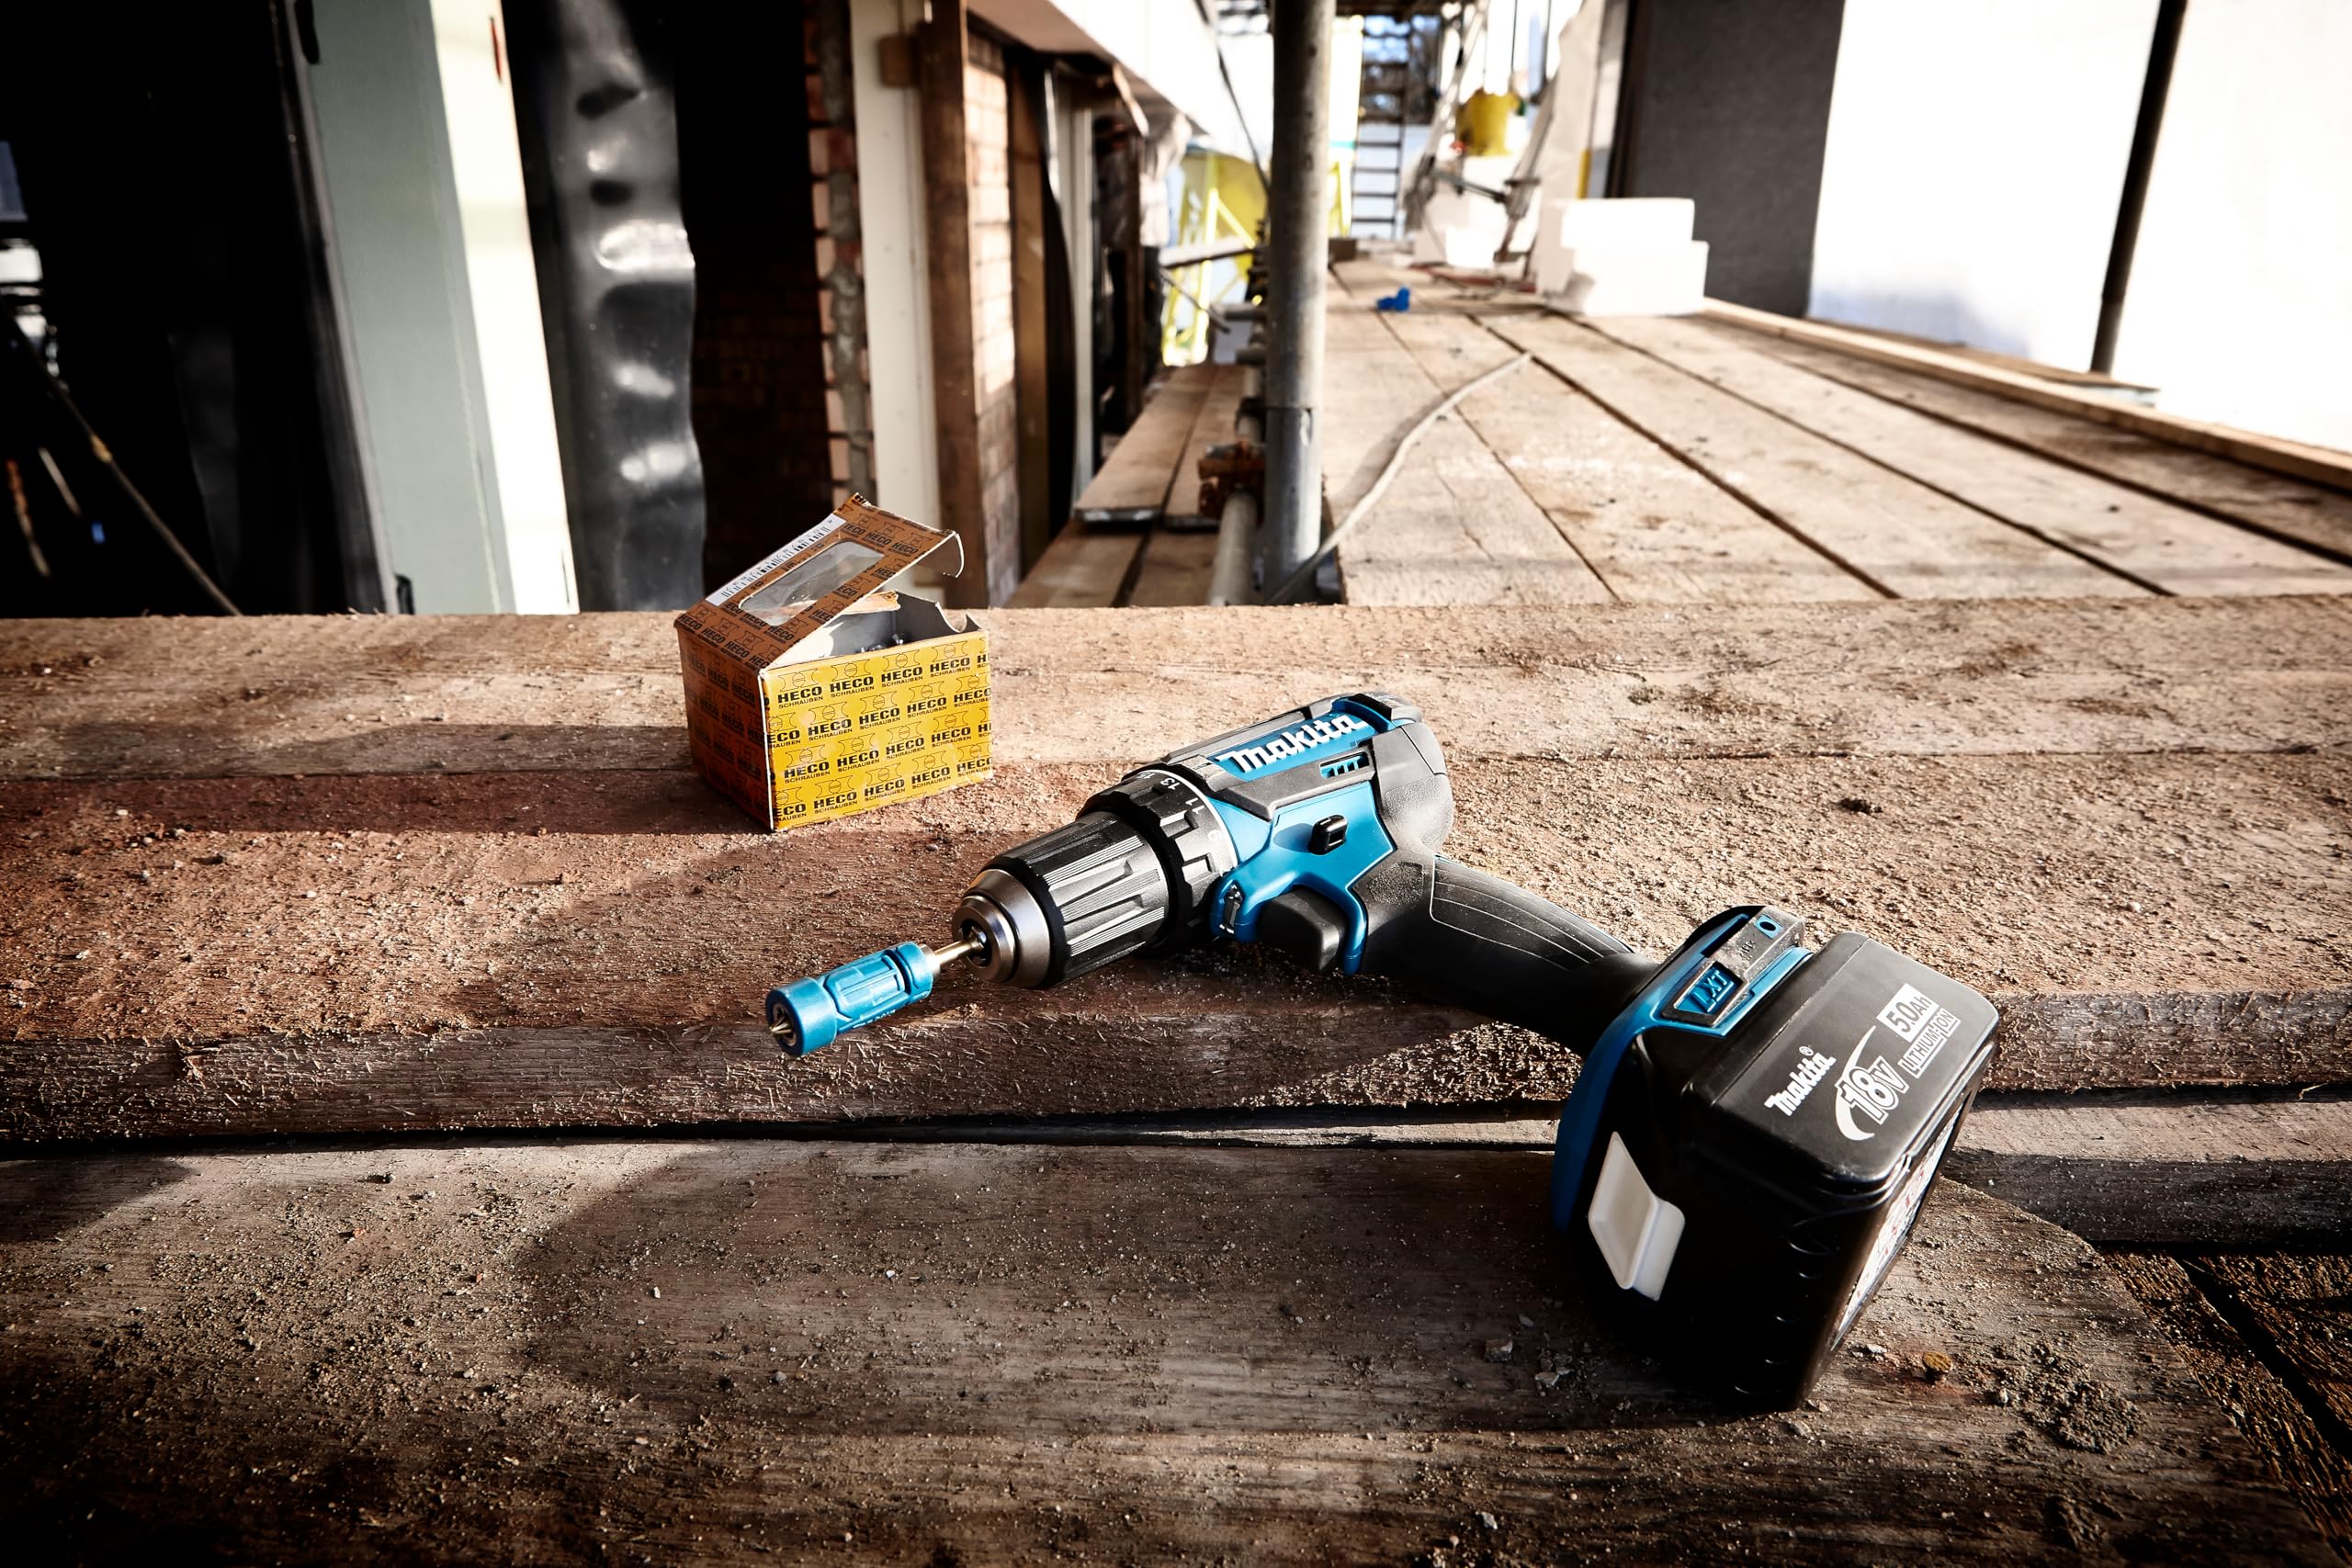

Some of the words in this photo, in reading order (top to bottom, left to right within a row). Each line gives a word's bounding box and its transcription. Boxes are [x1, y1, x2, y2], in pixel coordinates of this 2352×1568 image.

[836, 585, 858, 597] ECO
[875, 568, 897, 579] HEC
[812, 609, 835, 622] HEC
[701, 627, 726, 644] HECO
[724, 640, 751, 658] HECO
[749, 654, 771, 669] HEC
[778, 686, 822, 704] HECO
[830, 676, 874, 693] HECO
[881, 667, 922, 682] HECO
[930, 657, 970, 672] HECO
[778, 696, 823, 709] SCHRAUBEN
[831, 686, 875, 698] SCHRAUBEN
[882, 676, 923, 687] SCHRAUBEN
[930, 666, 970, 678] SCHRAUBEN
[767, 729, 800, 744] ECO
[808, 718, 852, 736] HECO
[859, 707, 900, 725] HECO
[907, 697, 947, 713] HECO
[808, 728, 853, 741] SCHRAUBEN
[859, 717, 900, 729] SCHRAUBEN
[907, 706, 947, 718] SCHRAUBEN
[784, 761, 830, 778] HECO
[837, 750, 879, 767] HECO
[886, 738, 924, 755] HECO
[932, 727, 971, 742] HECO
[785, 771, 831, 784] SCHRAUBEN
[838, 759, 879, 773] SCHRAUBEN
[886, 747, 925, 760] SCHRAUBEN
[932, 736, 971, 747] SCHRAUBEN
[774, 803, 806, 817] ECO
[814, 792, 857, 808] HECO
[865, 779, 905, 796] HECO
[911, 767, 950, 784] HECO
[814, 800, 858, 814] SCHRAUBEN
[865, 788, 906, 801] SCHRAUBEN
[911, 776, 951, 789] SCHRAUBEN
[1160, 778, 1181, 790] 13
[1185, 797, 1204, 815] 11
[1691, 969, 1735, 1012] LXT
[1900, 1010, 1955, 1076] LITHIUM-ION
